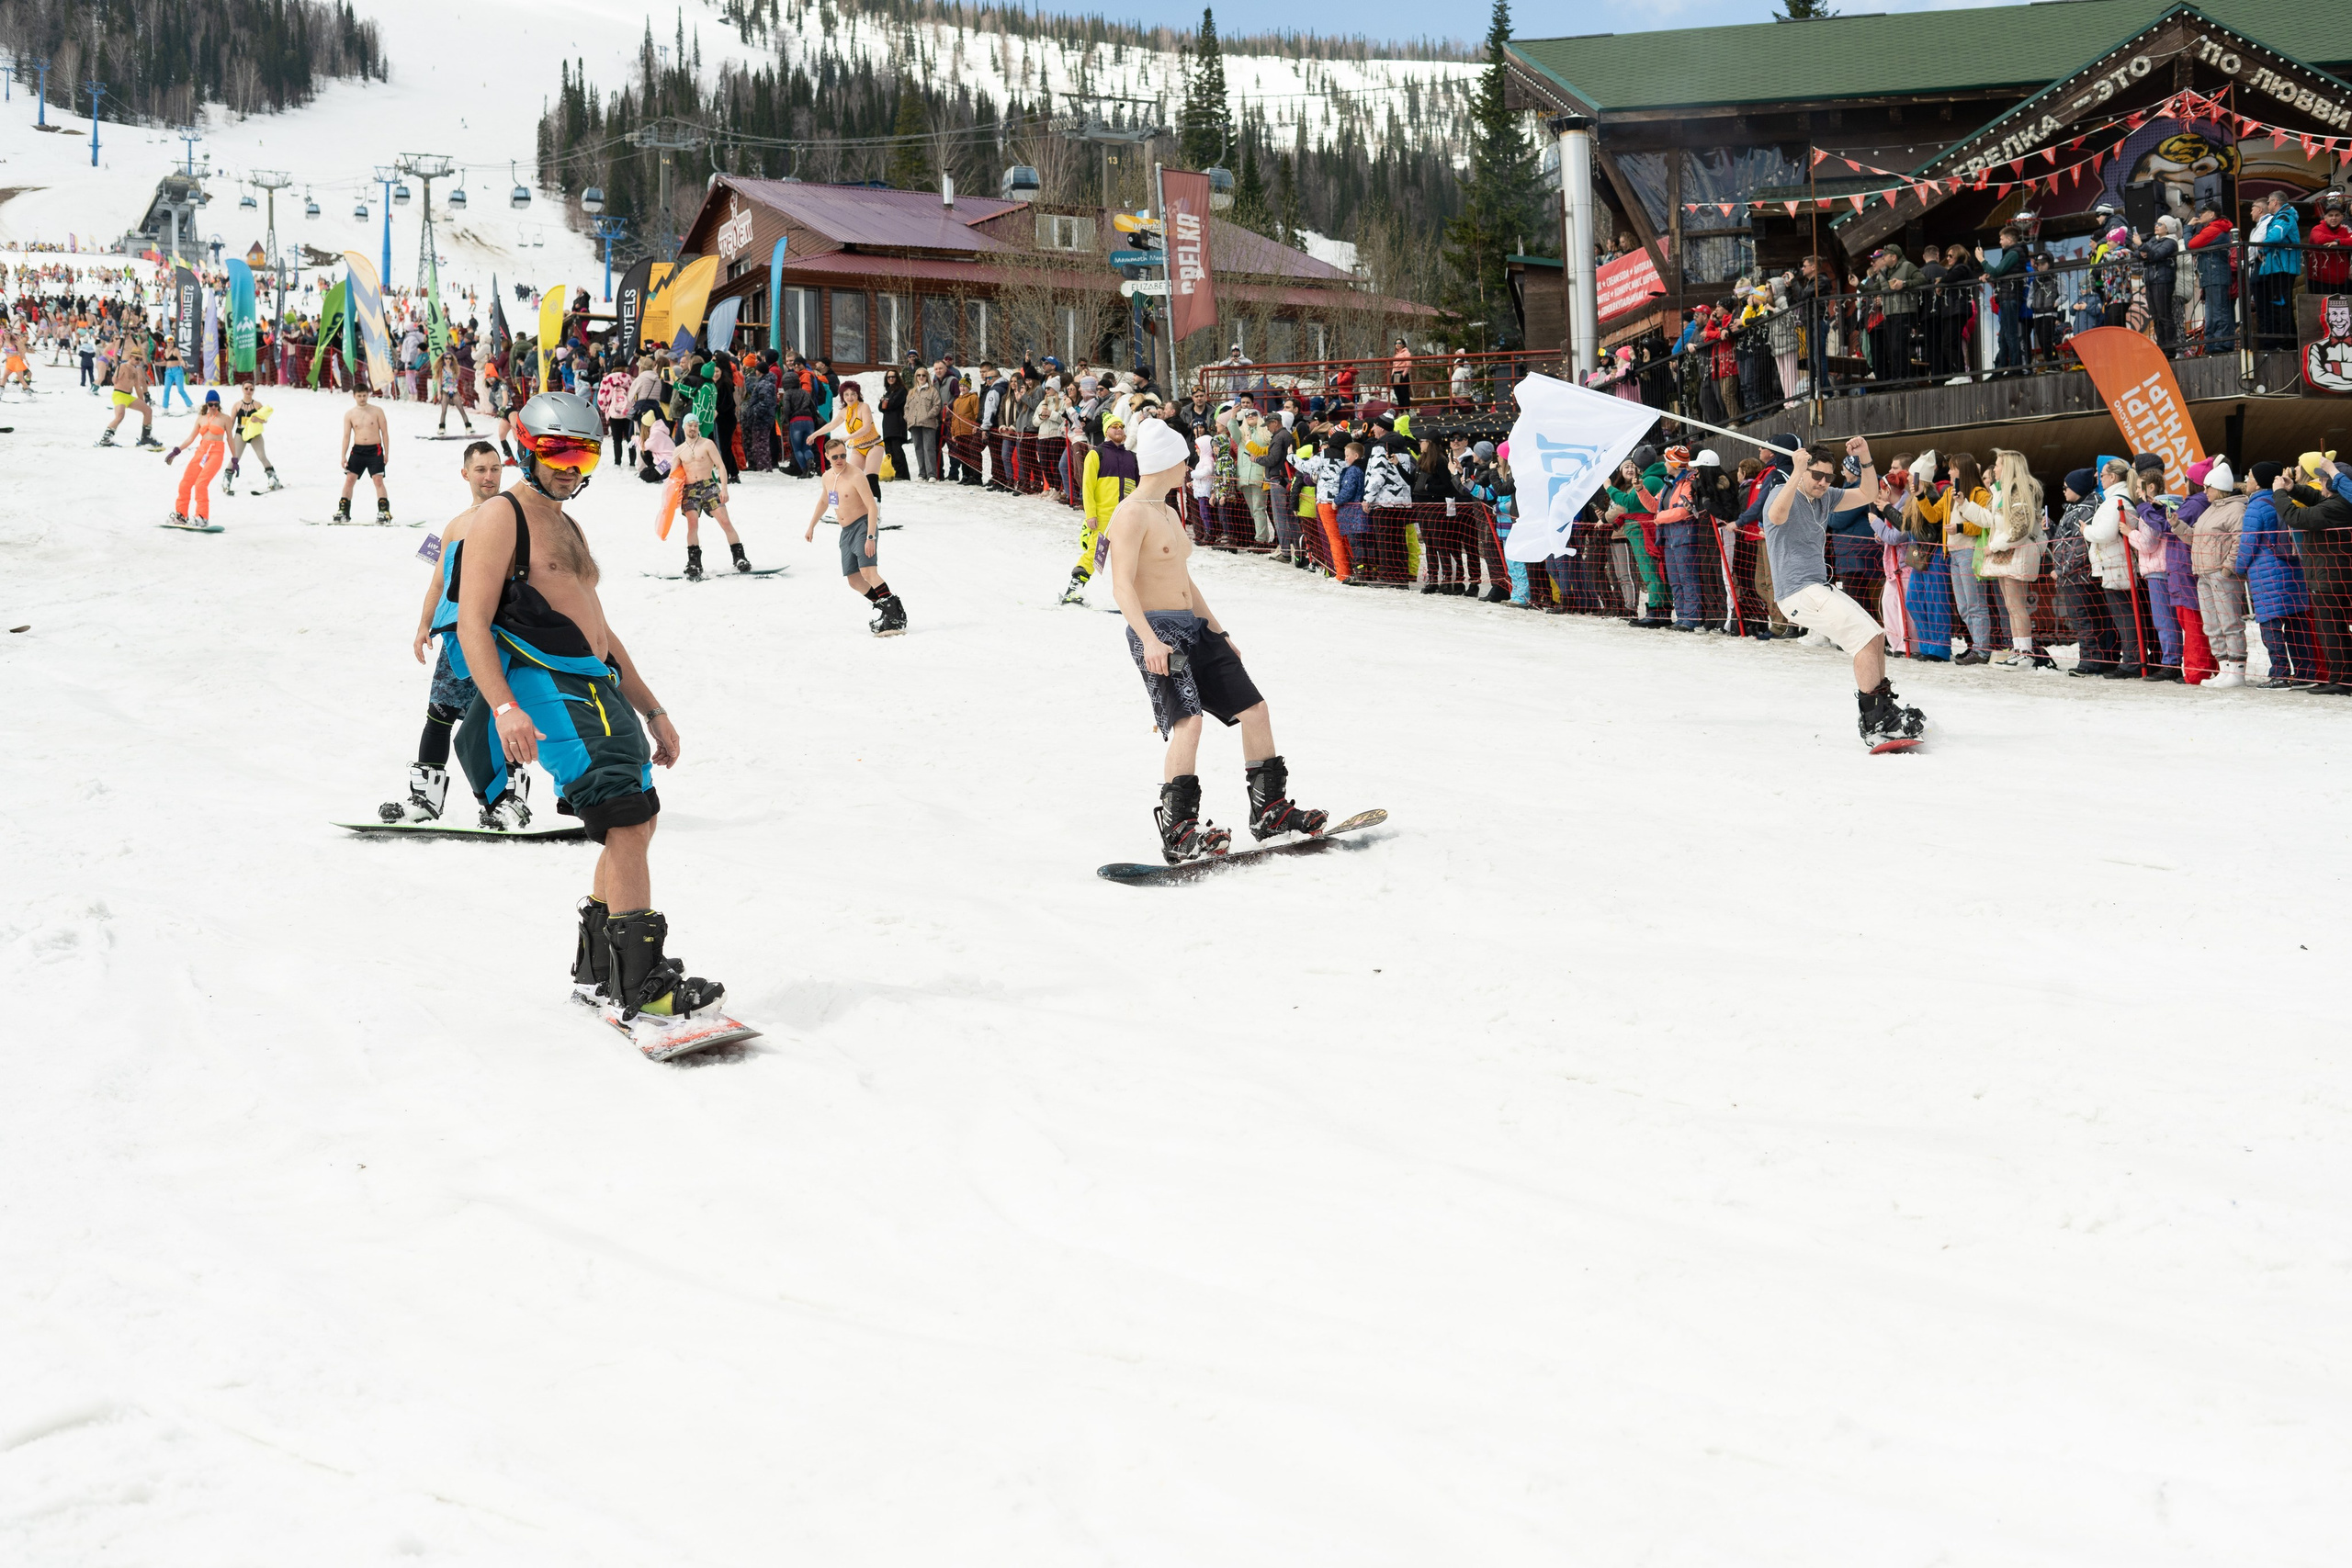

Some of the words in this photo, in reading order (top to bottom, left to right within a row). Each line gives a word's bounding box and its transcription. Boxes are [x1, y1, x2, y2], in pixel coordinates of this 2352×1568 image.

[1951, 115, 2064, 183] ГРЕЛКА
[2199, 39, 2242, 75] ПО
[2249, 66, 2352, 130] ЛЮБВИ
[1107, 156, 1118, 165] 13
[1177, 212, 1201, 295] GRELKA
[1131, 282, 1171, 291] ELIZABE
